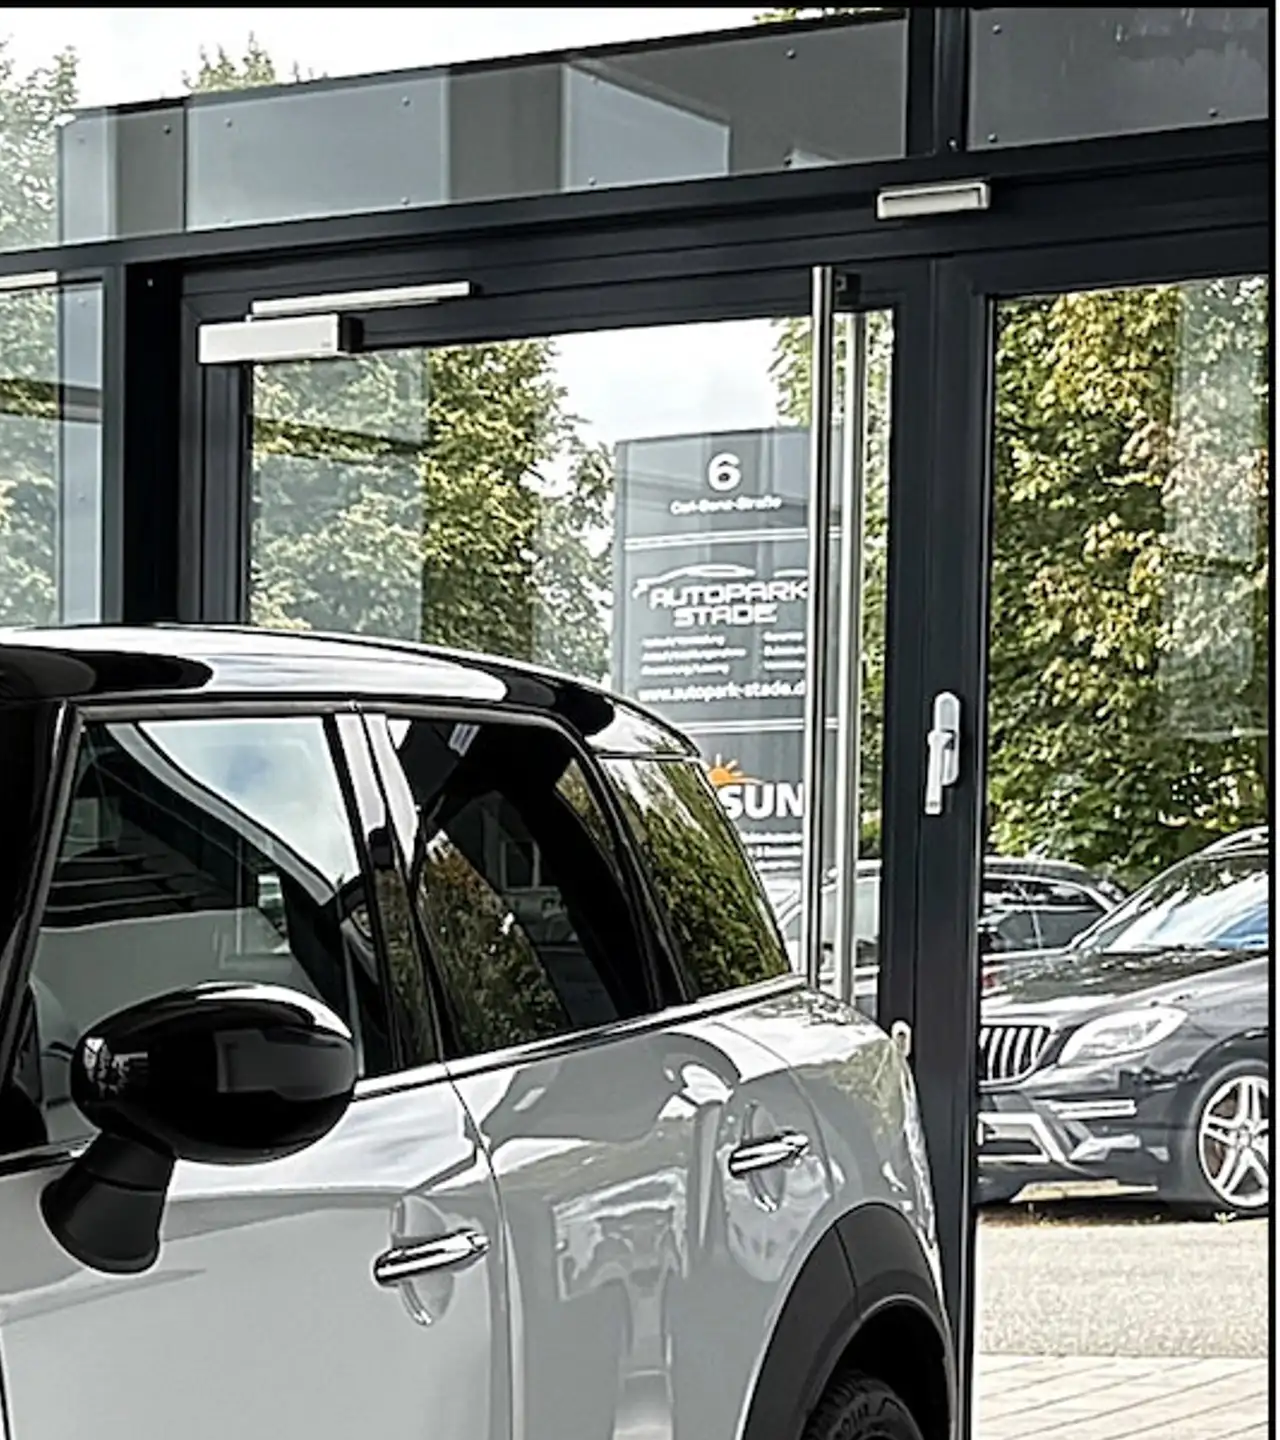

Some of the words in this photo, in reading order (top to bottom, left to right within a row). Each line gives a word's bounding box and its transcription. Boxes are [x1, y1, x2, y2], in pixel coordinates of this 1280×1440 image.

[708, 453, 741, 491] 6
[650, 581, 808, 609] AUTOPARK
[673, 603, 778, 628] STADE
[717, 782, 804, 820] SUN
